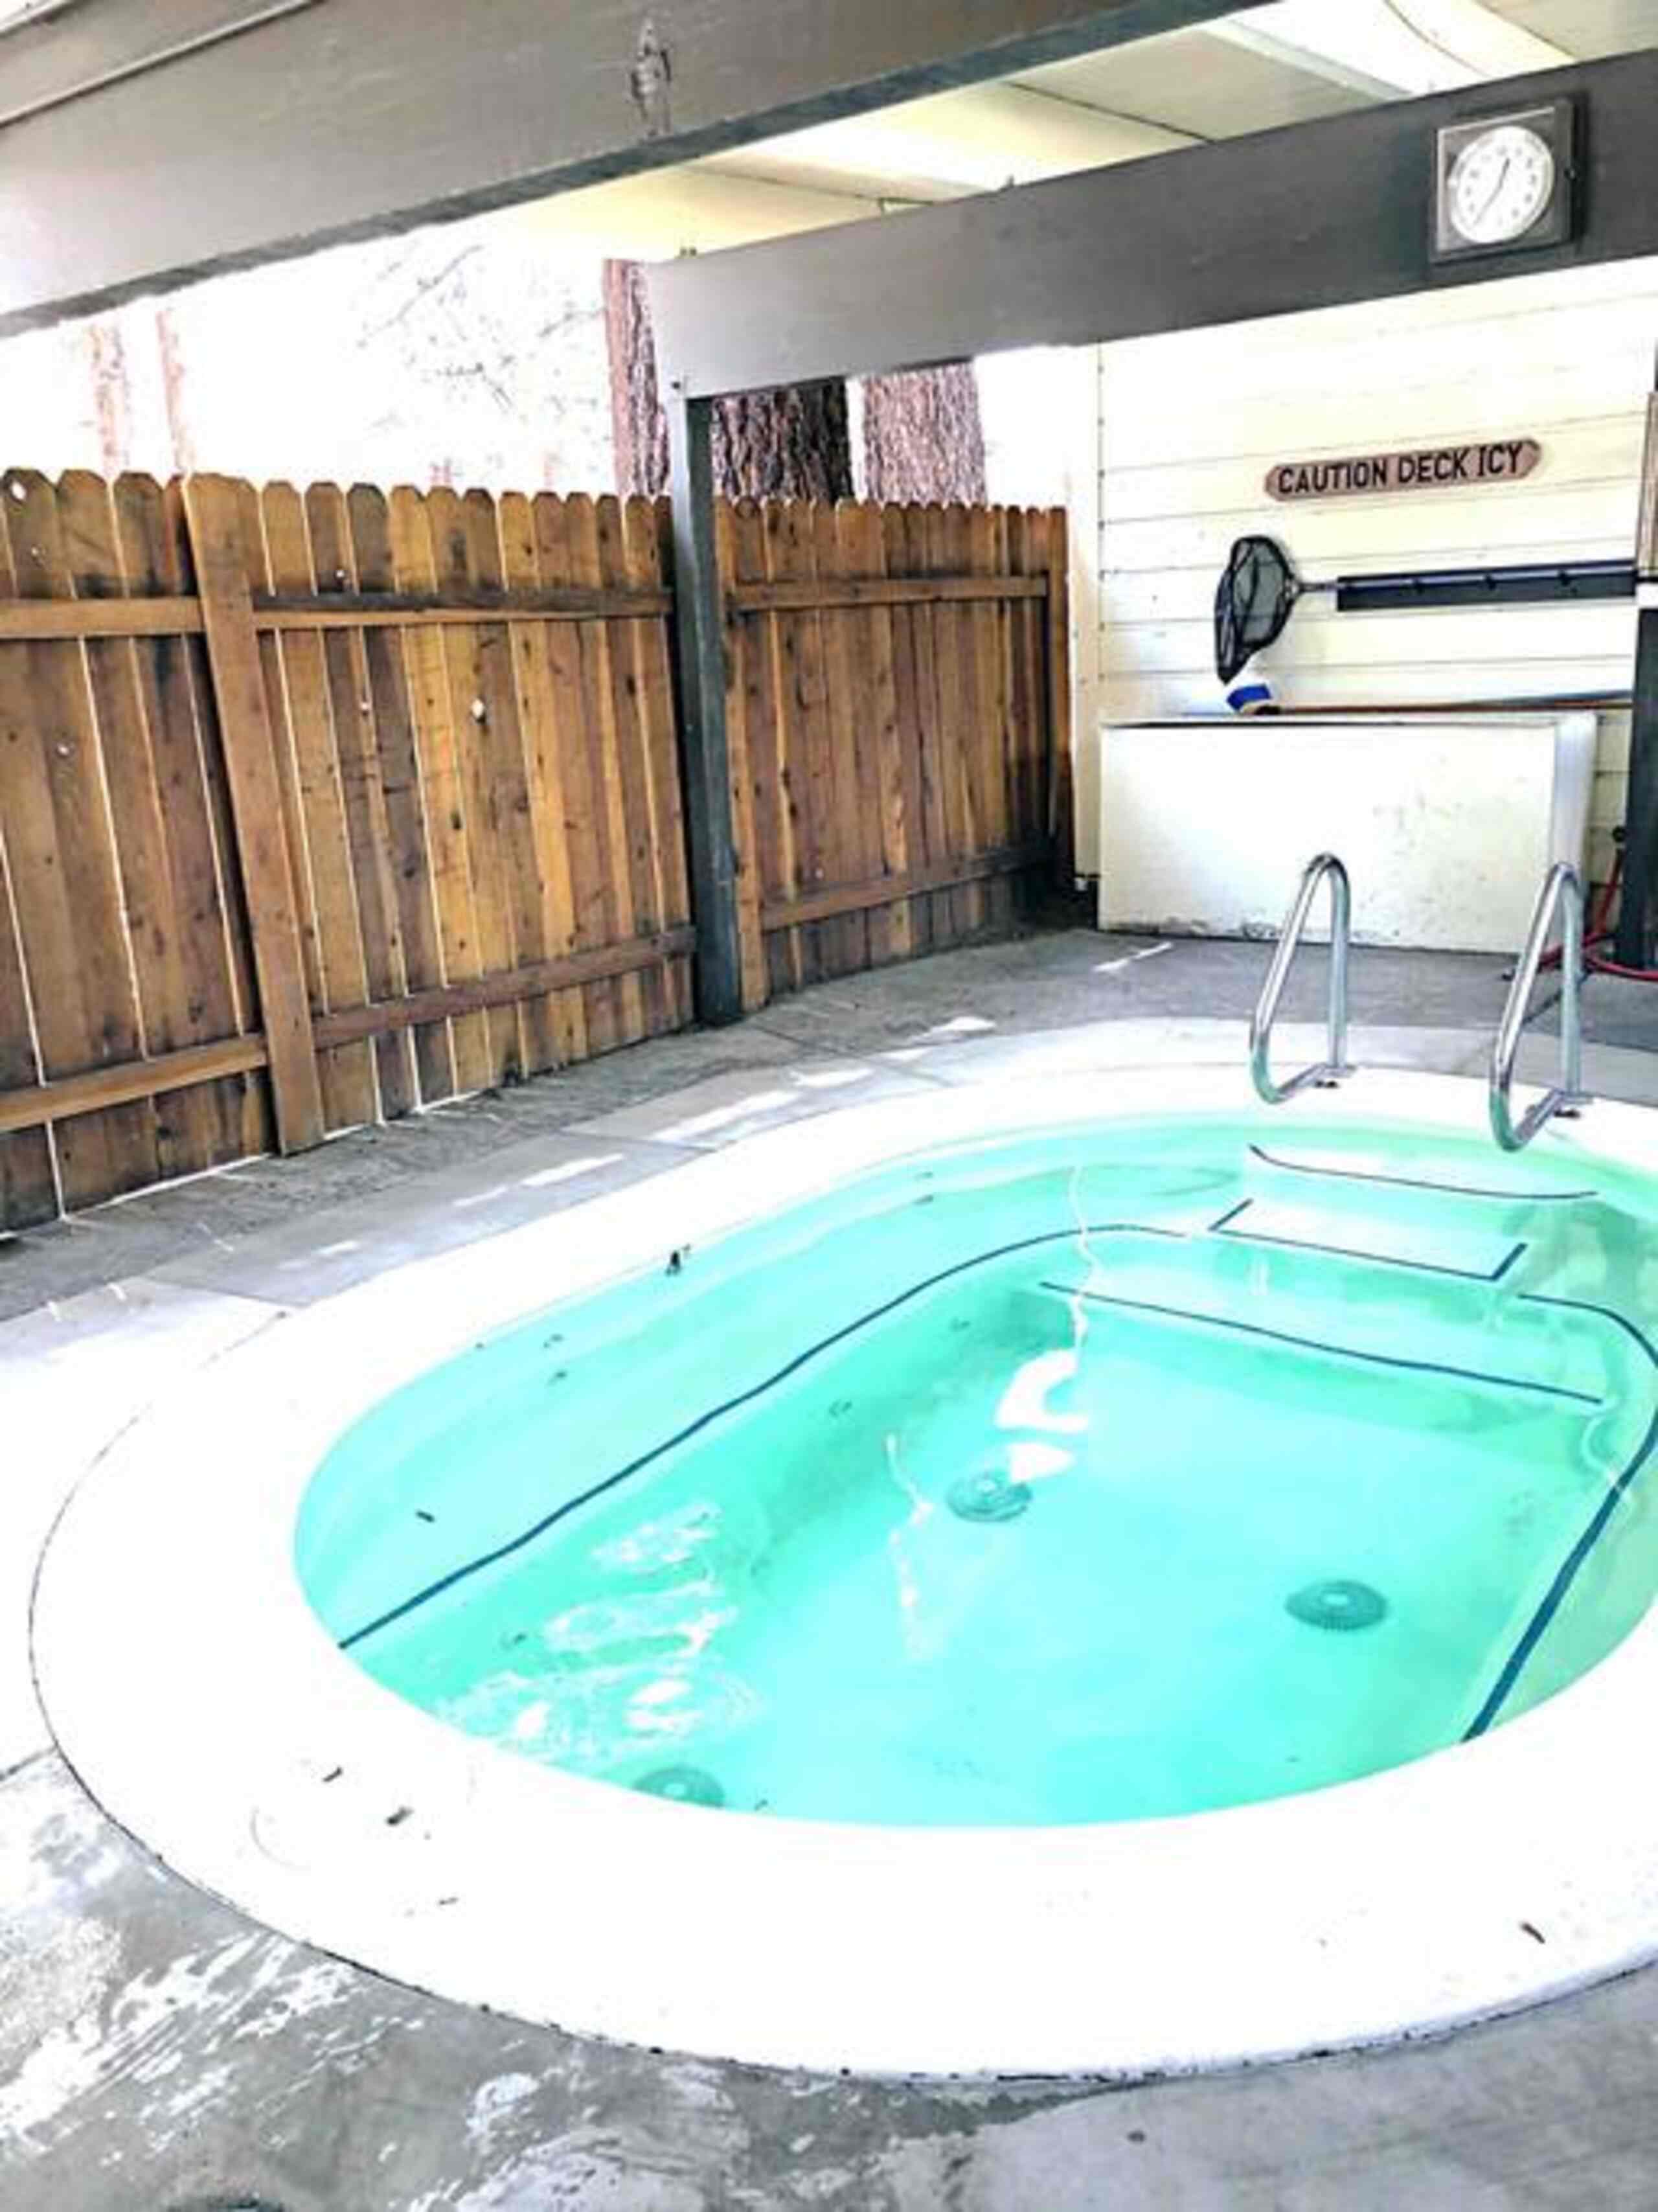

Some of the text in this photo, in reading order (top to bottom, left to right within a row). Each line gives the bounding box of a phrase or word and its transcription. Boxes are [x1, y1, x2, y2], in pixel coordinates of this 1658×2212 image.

[1278, 442, 1523, 494] CAUTION DECK ICY
